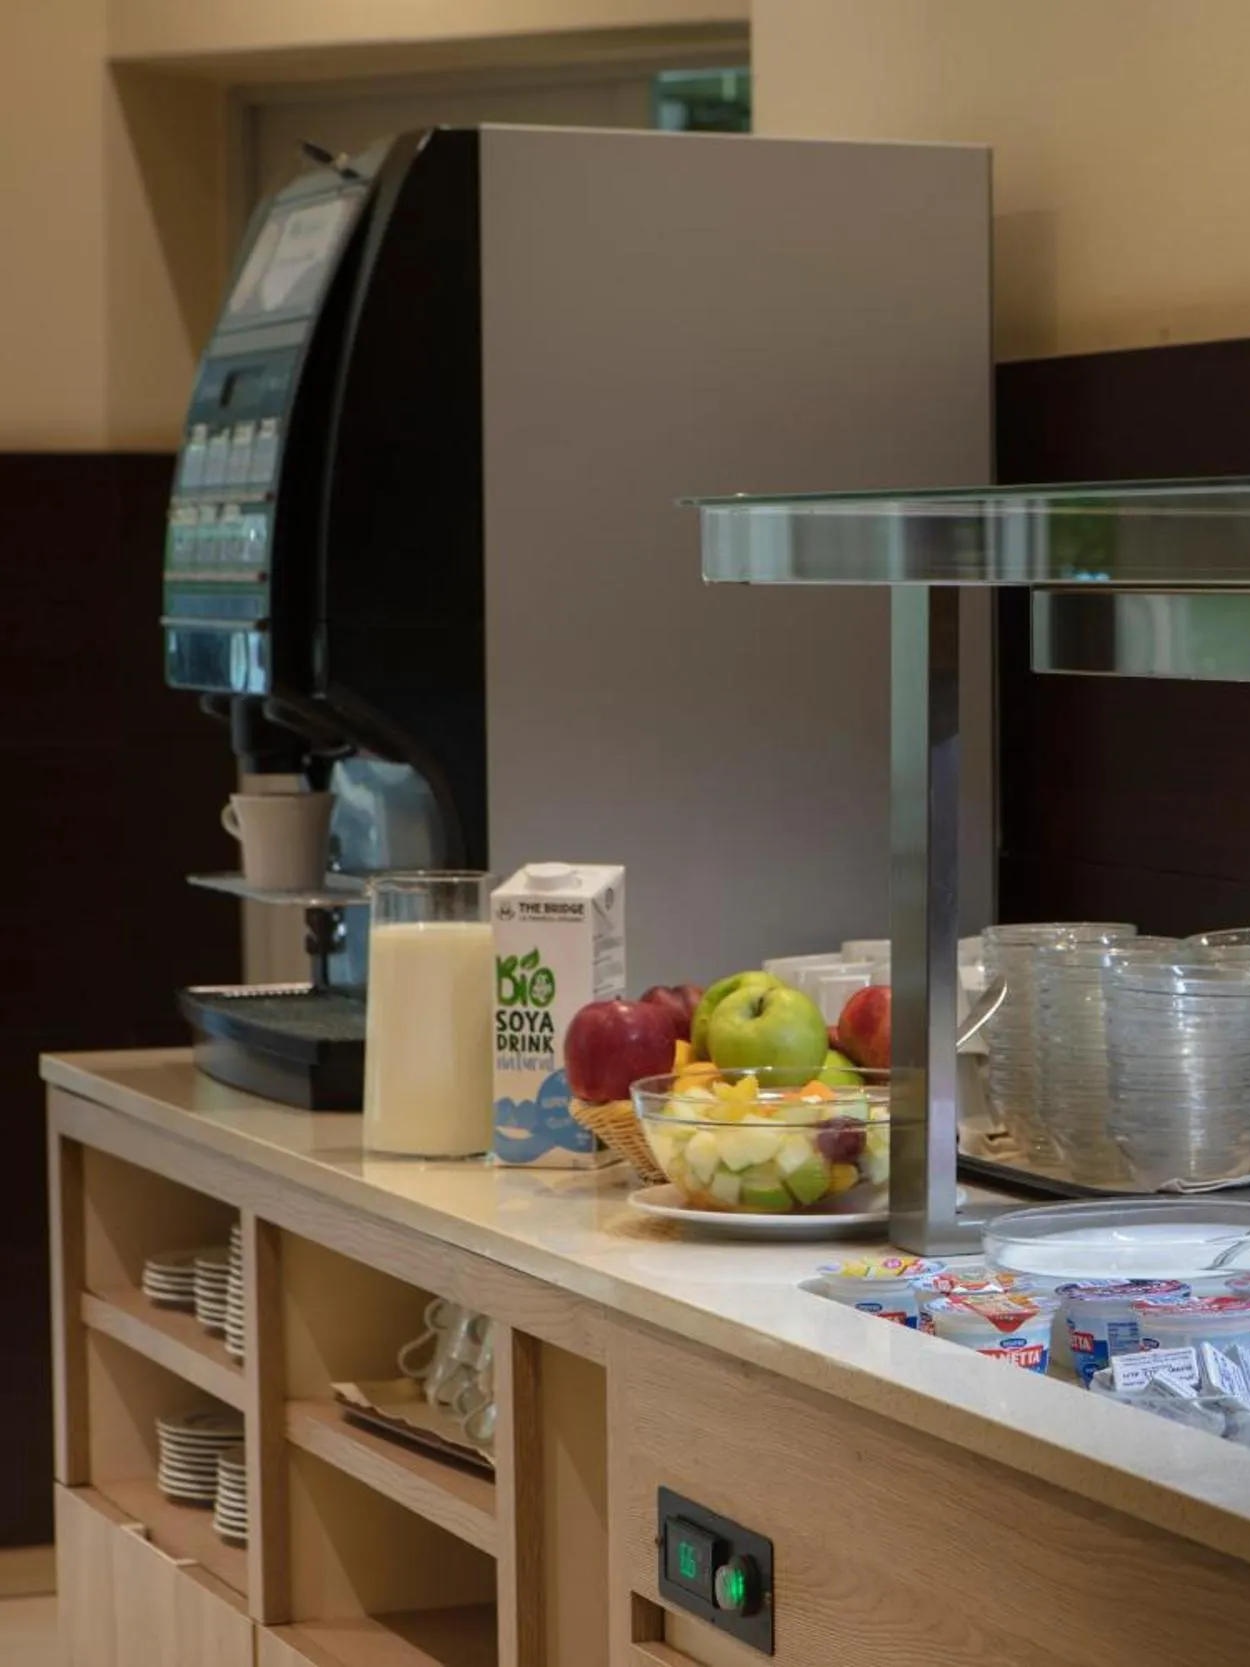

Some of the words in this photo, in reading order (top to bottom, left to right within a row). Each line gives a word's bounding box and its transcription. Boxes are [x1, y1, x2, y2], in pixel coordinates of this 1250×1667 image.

[518, 902, 541, 914] THE
[496, 1010, 554, 1033] SOYA
[496, 1034, 554, 1054] DRINK
